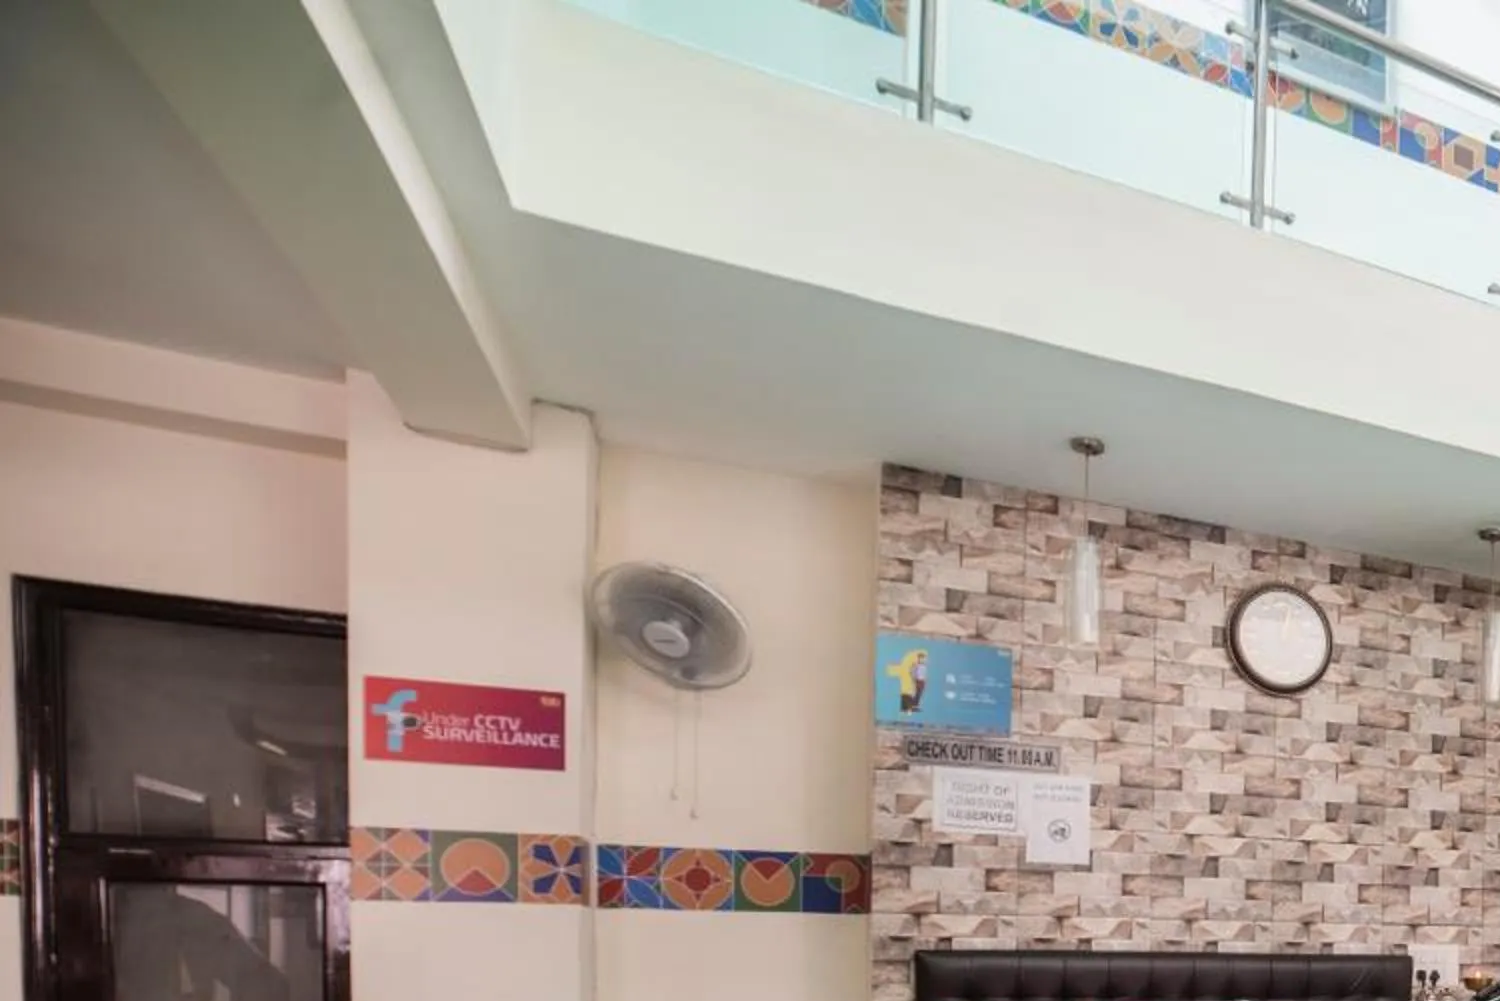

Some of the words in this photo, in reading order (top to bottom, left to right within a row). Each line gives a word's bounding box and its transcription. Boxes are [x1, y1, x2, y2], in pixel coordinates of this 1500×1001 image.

[422, 711, 470, 728] Under
[473, 714, 521, 731] CCTV
[422, 726, 561, 748] SURVEILLANCE
[907, 740, 949, 758] CHECK
[951, 743, 974, 761] OUT
[978, 745, 1004, 763] TIME
